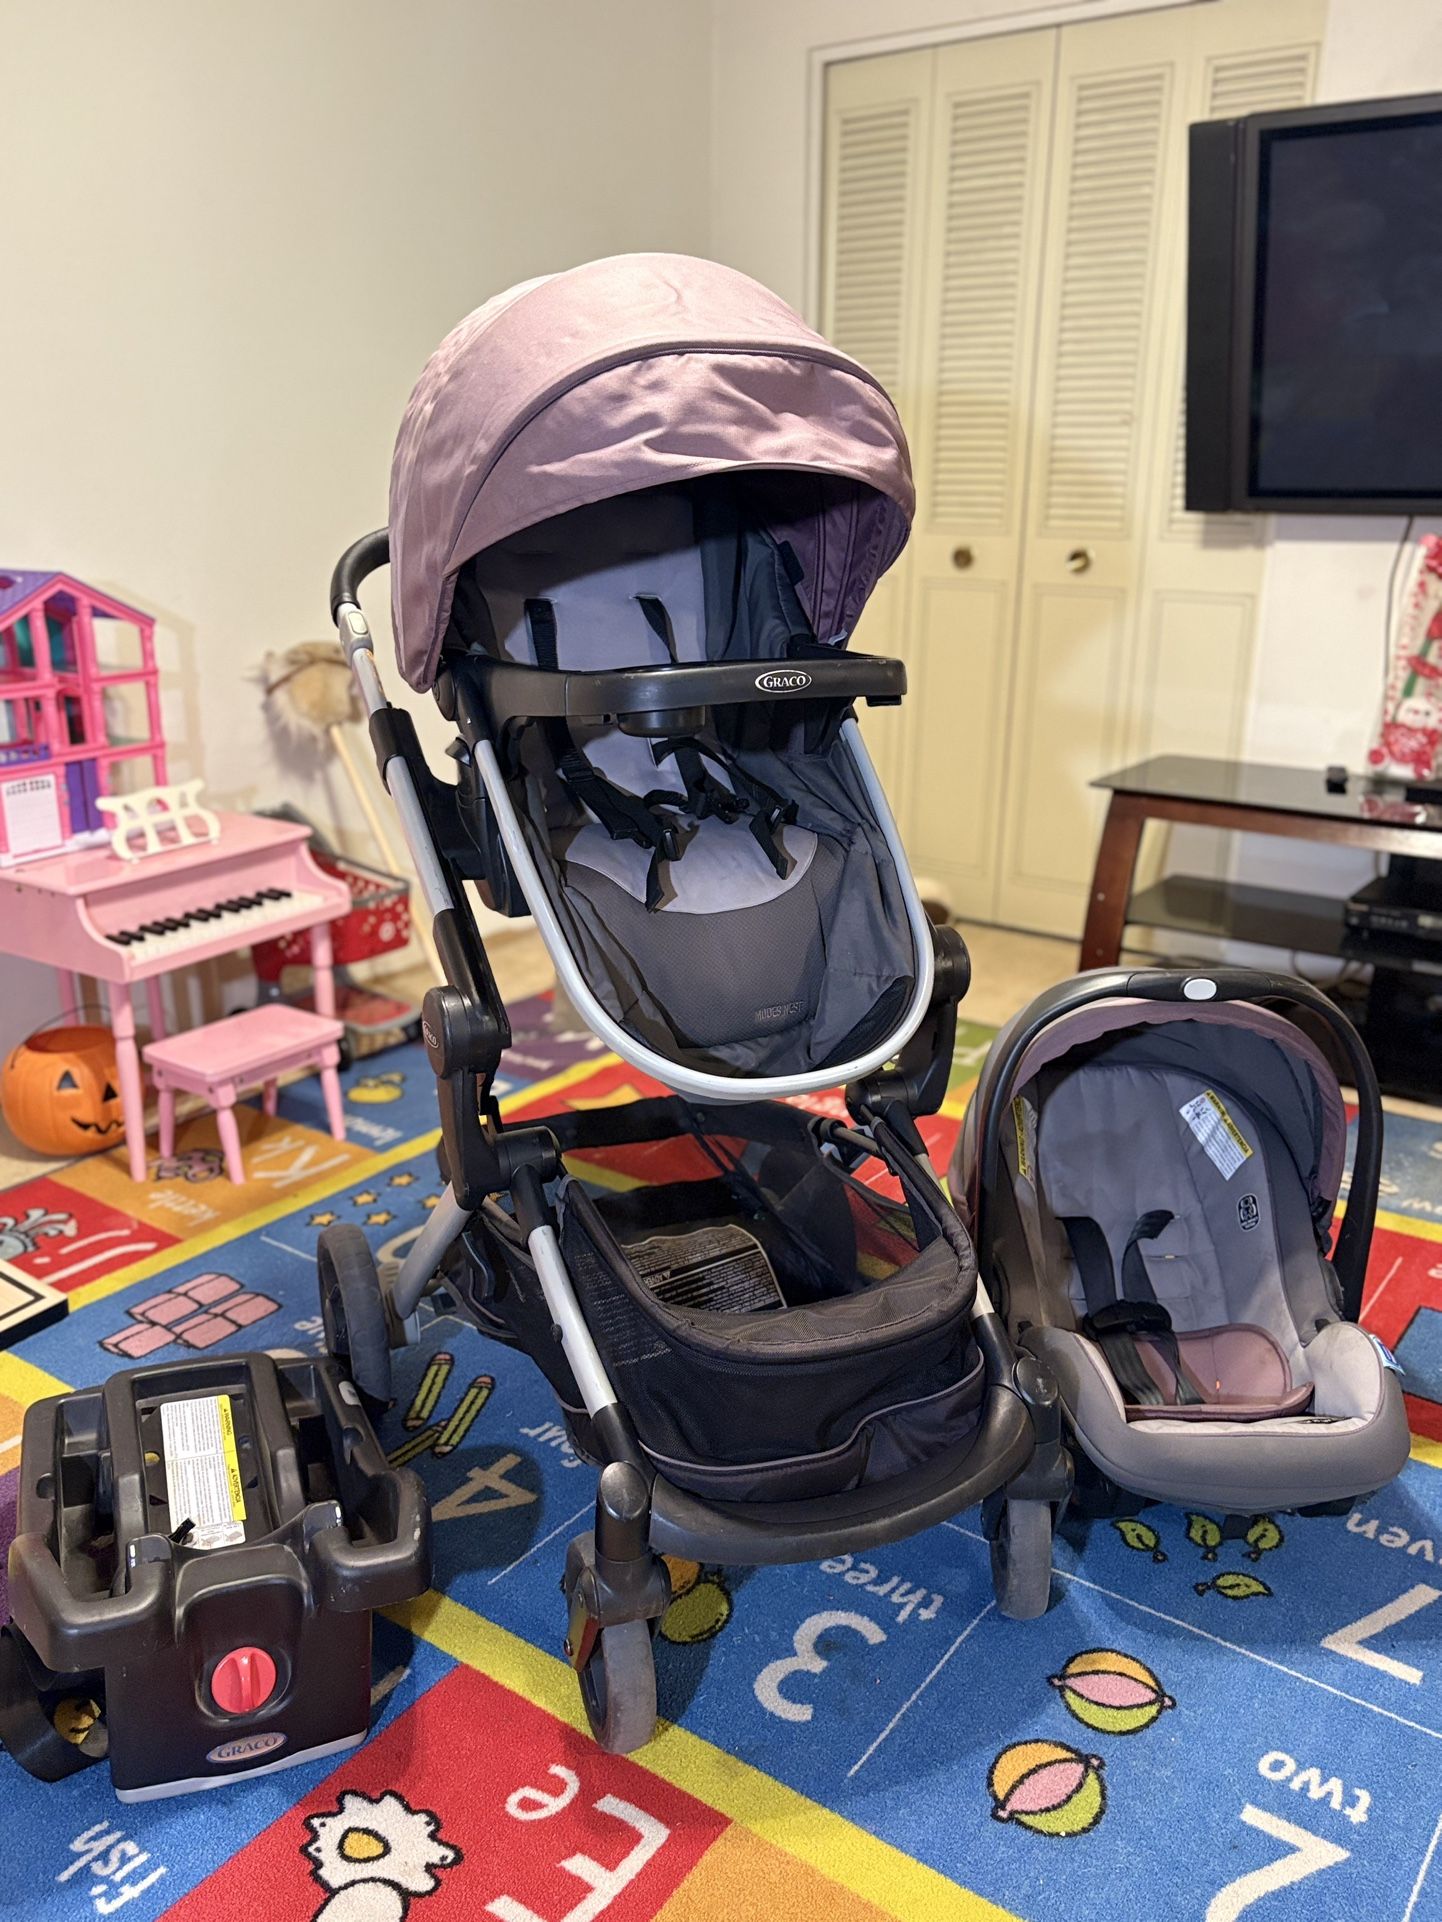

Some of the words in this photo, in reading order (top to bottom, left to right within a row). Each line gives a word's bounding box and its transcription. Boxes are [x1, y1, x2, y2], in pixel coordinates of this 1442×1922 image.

[763, 675, 806, 688] GRACO
[431, 1452, 539, 1522] 4
[1346, 1512, 1442, 1565] ven
[819, 1553, 944, 1624] three
[754, 1610, 888, 1722] 3
[1320, 1582, 1442, 1685] 7
[217, 1735, 278, 1759] GRACO
[505, 1763, 581, 1821] e
[1257, 1750, 1372, 1825] two
[55, 1820, 169, 1915] fish
[484, 1793, 671, 1922] E
[1205, 1802, 1351, 1922] 2
